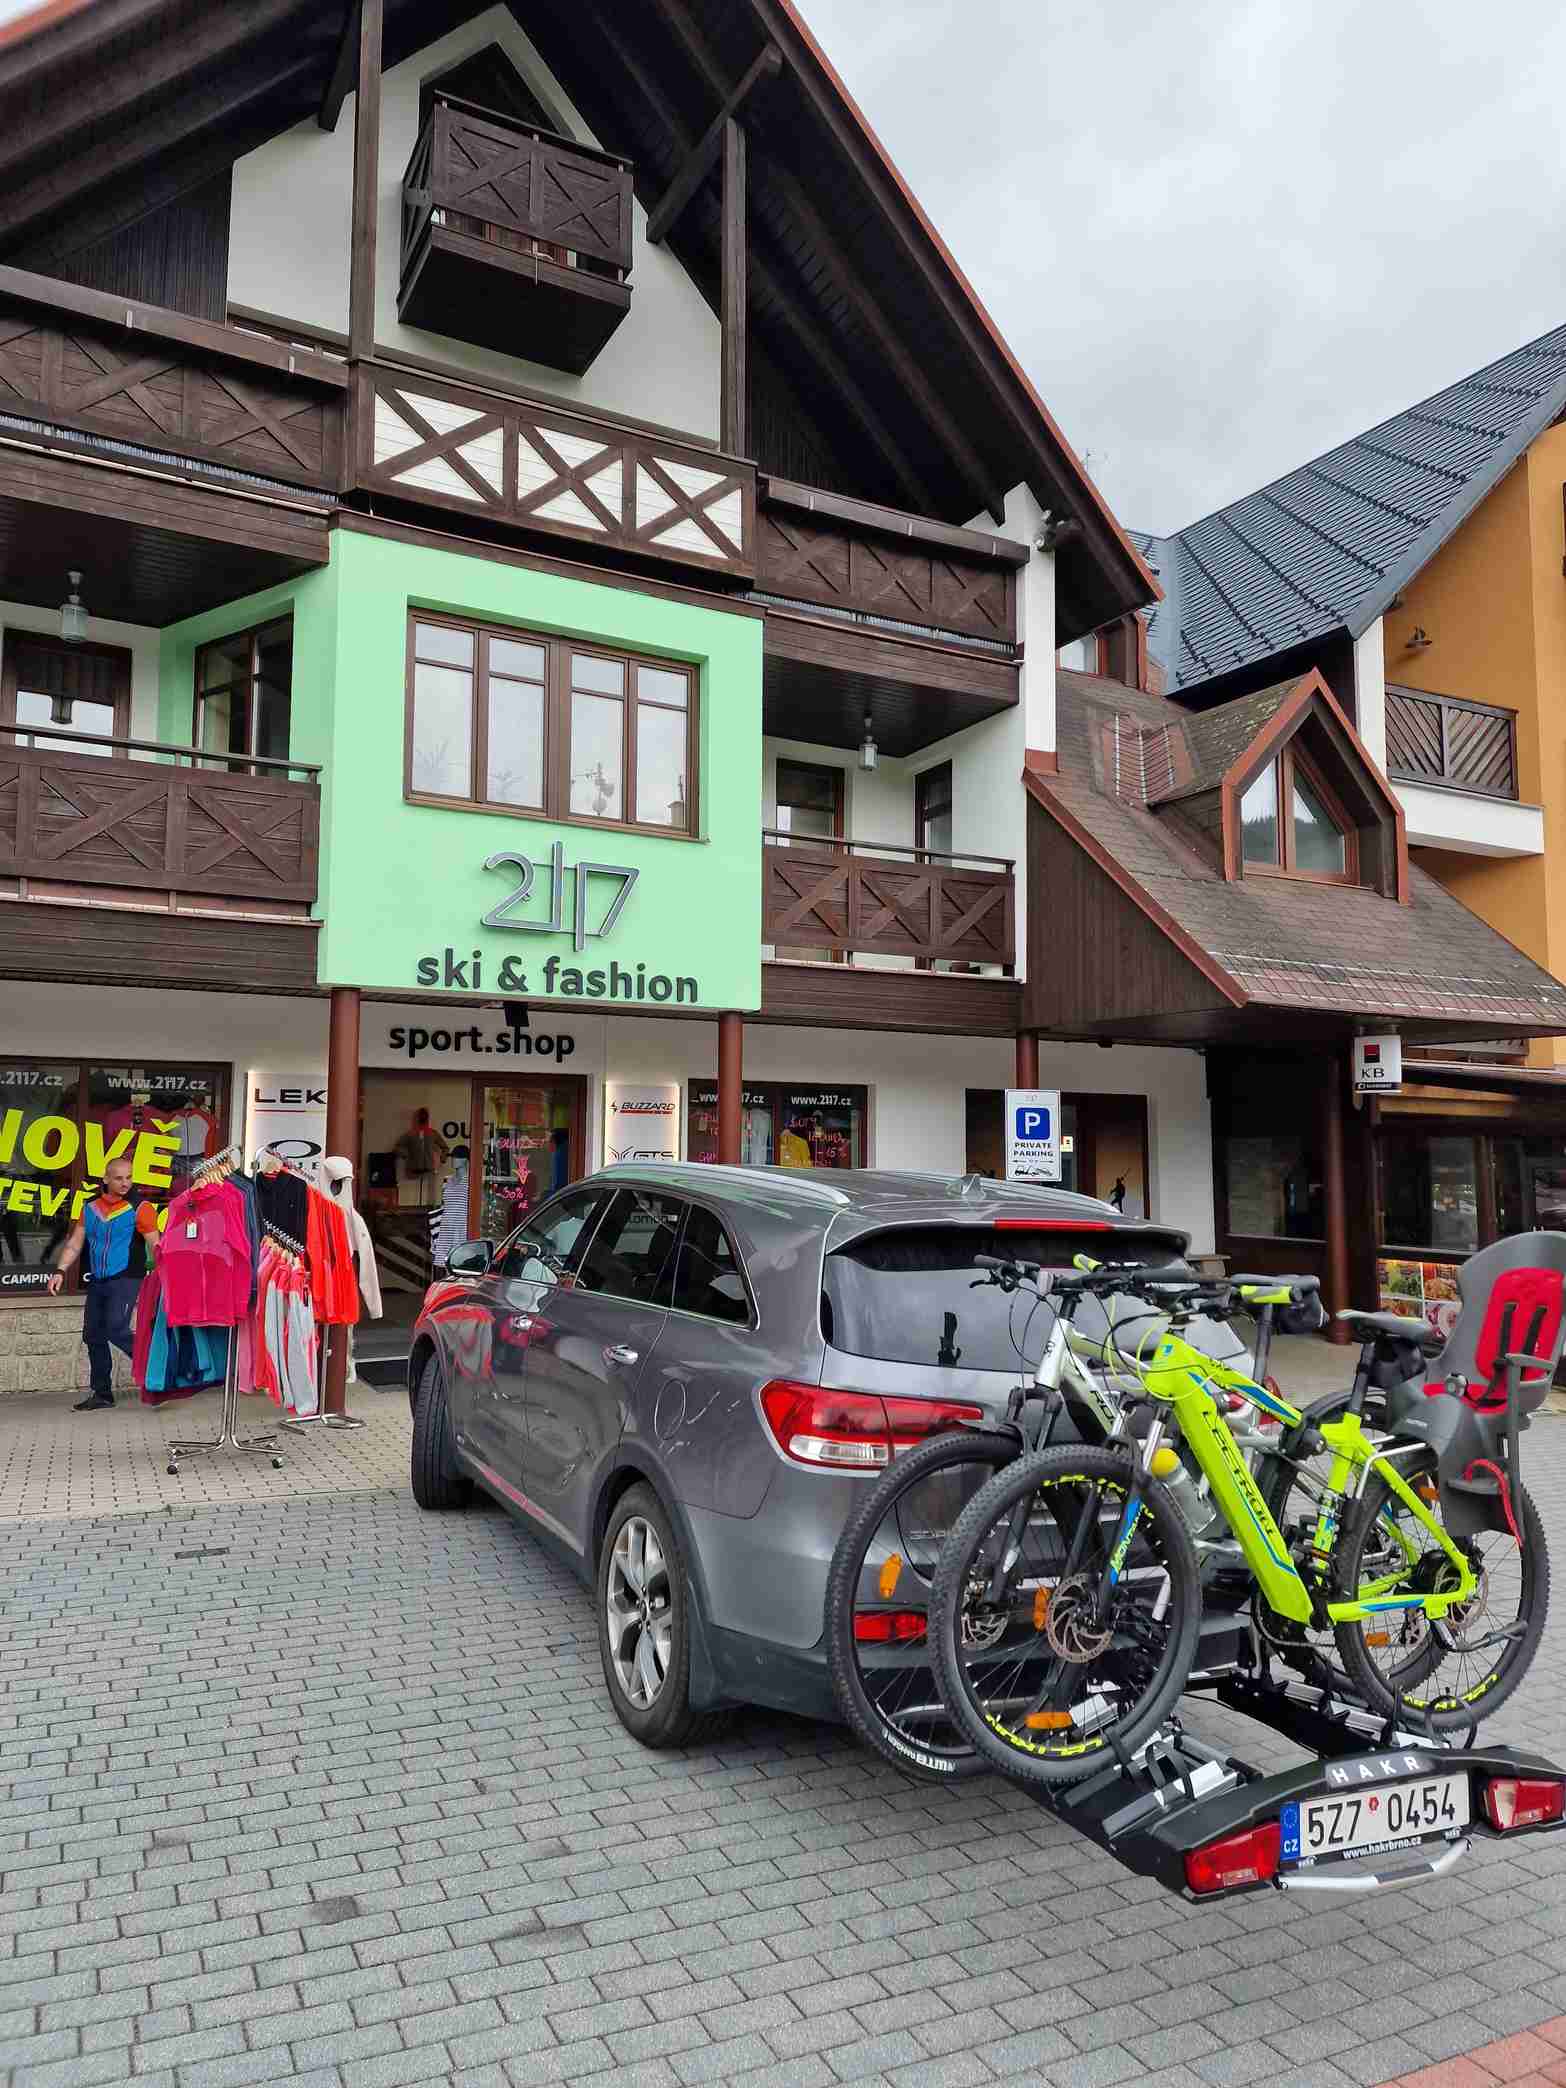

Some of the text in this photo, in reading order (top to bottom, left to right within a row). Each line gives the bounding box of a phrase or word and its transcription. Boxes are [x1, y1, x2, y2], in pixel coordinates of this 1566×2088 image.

[416, 947, 699, 1003] ski & fashion
[388, 1024, 575, 1063] sport.shop
[1361, 1067, 1385, 1079] KB
[108, 1076, 208, 1091] www.2117.cz
[255, 1088, 328, 1105] LEK
[790, 1093, 853, 1106] www.2117.cz
[1024, 1111, 1041, 1136] P
[1, 1272, 60, 1286] CAMPIN
[1331, 1755, 1421, 1784] HAKR
[1307, 1782, 1456, 1847] 5Z7 0454
[1283, 1838, 1299, 1854] CZ
